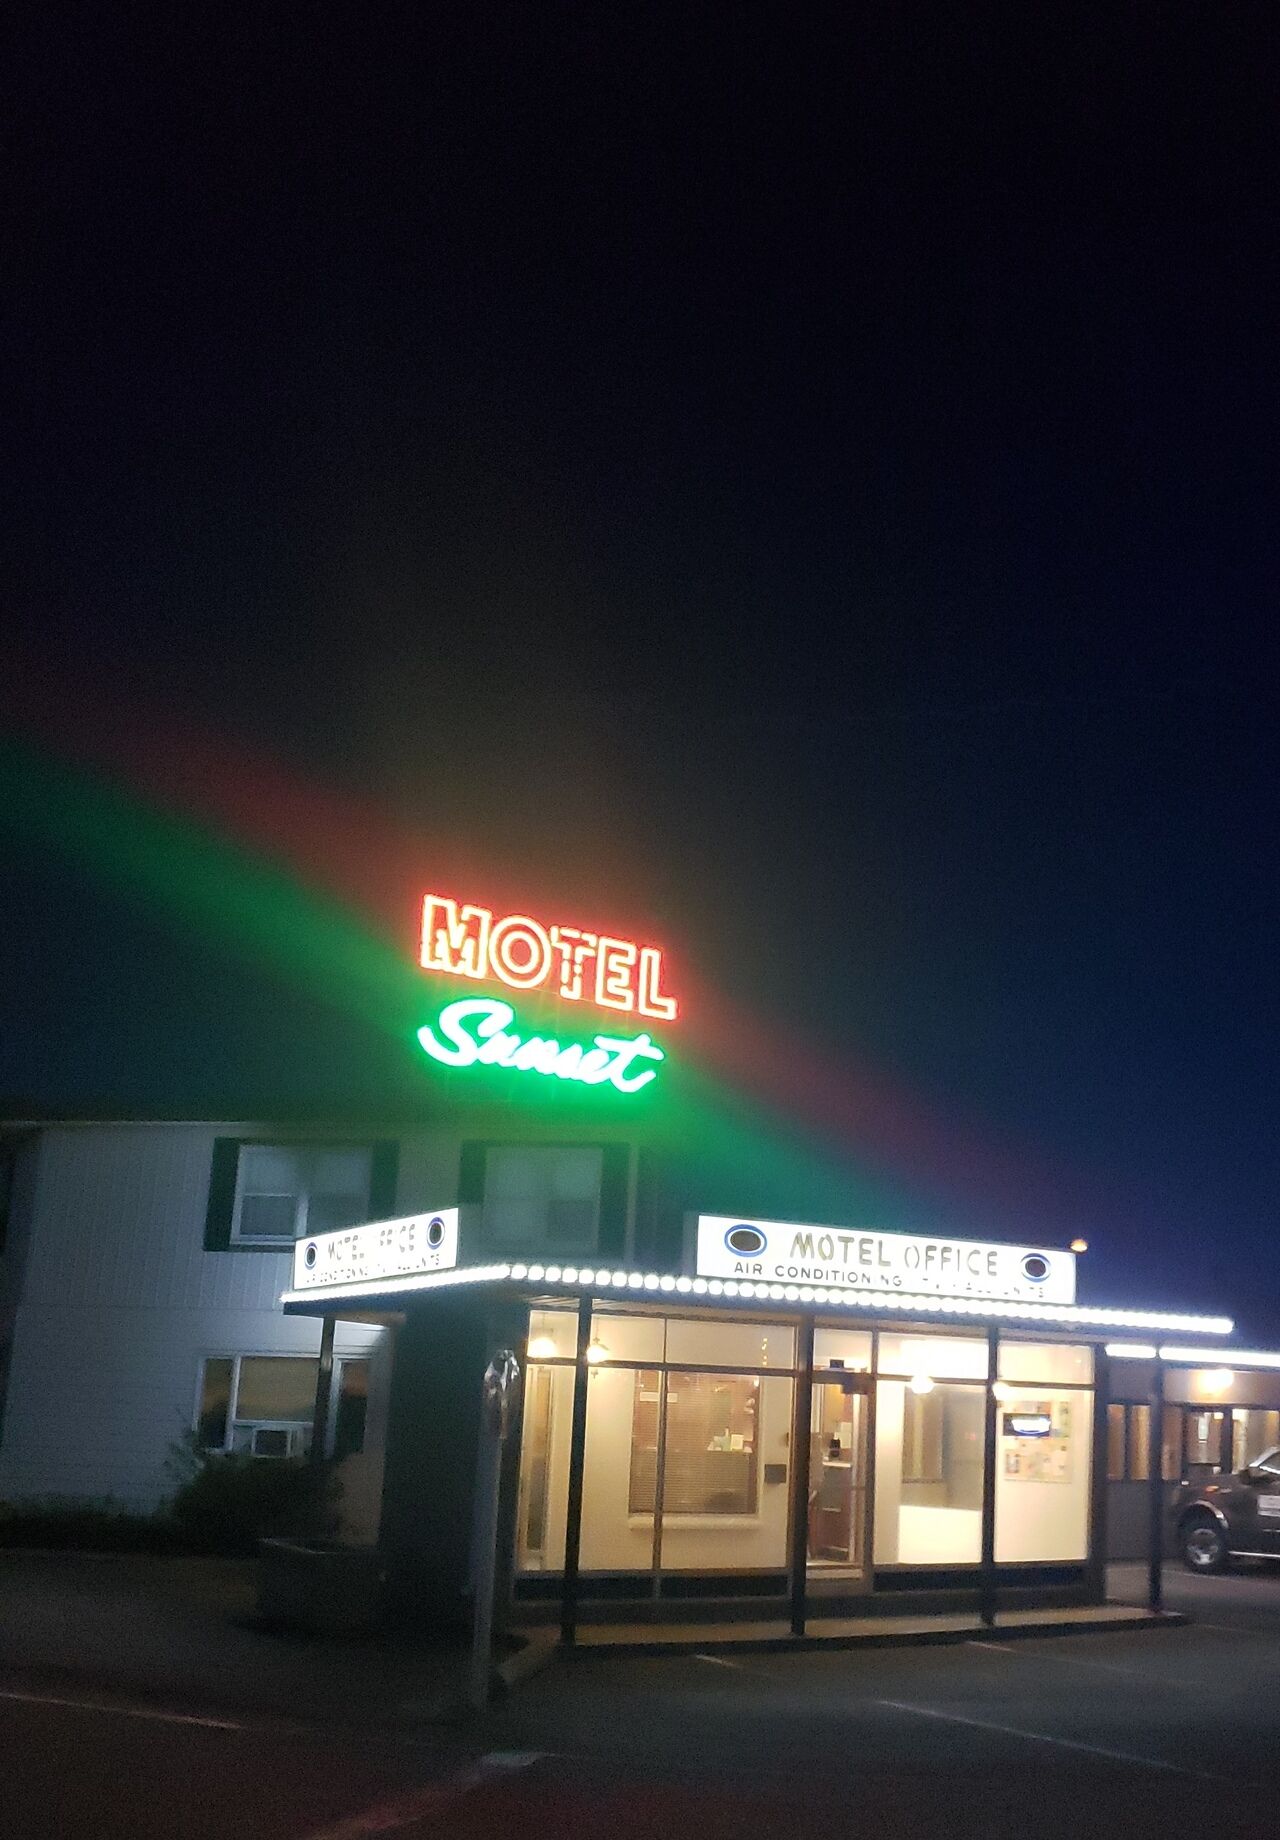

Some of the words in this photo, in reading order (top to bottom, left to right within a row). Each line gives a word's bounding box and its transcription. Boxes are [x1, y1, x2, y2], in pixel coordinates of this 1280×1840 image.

[420, 893, 677, 1021] MOTEL
[417, 996, 665, 1093] Sunset
[328, 1234, 365, 1261] MOTE
[789, 1231, 892, 1268] MOTEL
[904, 1245, 998, 1277] OFFICE
[734, 1261, 763, 1276] AIR
[775, 1264, 903, 1287] CONDITIONNG
